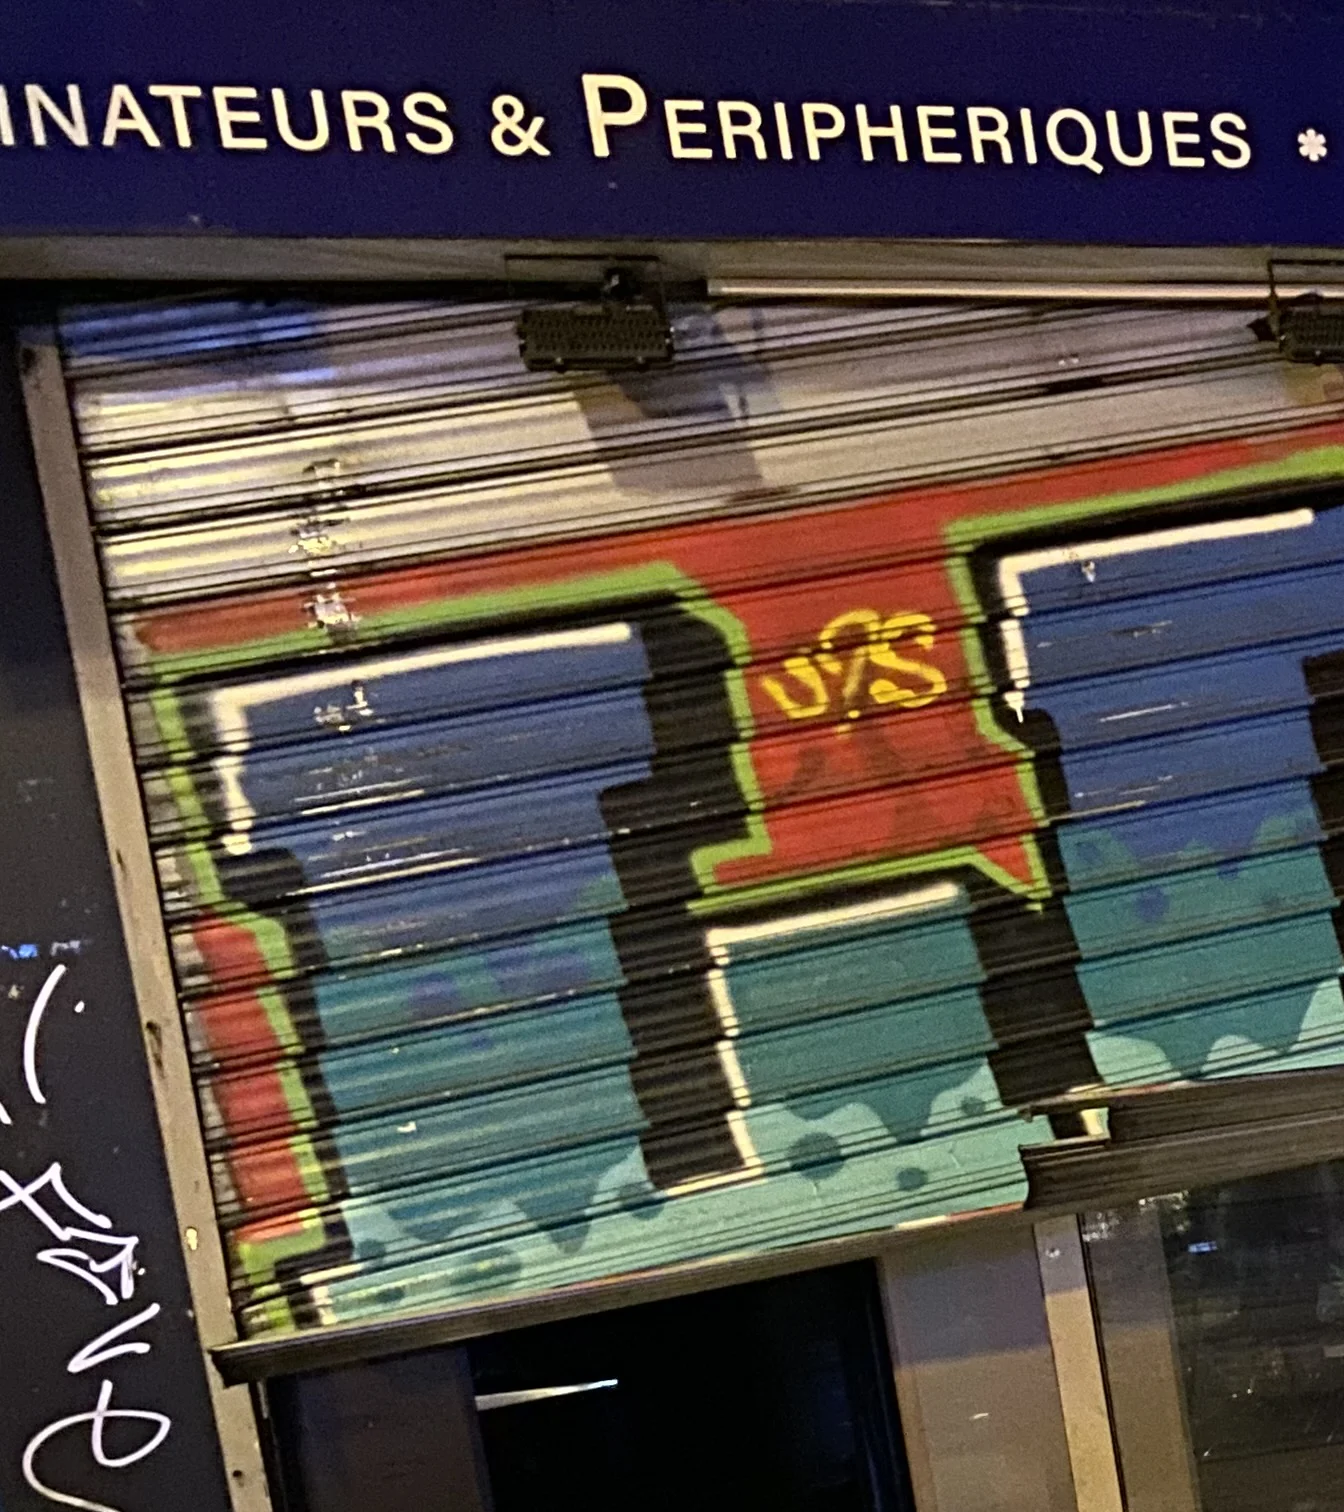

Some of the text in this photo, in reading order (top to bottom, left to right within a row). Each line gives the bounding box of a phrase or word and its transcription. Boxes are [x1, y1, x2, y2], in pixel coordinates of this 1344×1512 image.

[0, 72, 1253, 176] INATEURS & PERIPHERIQUES
